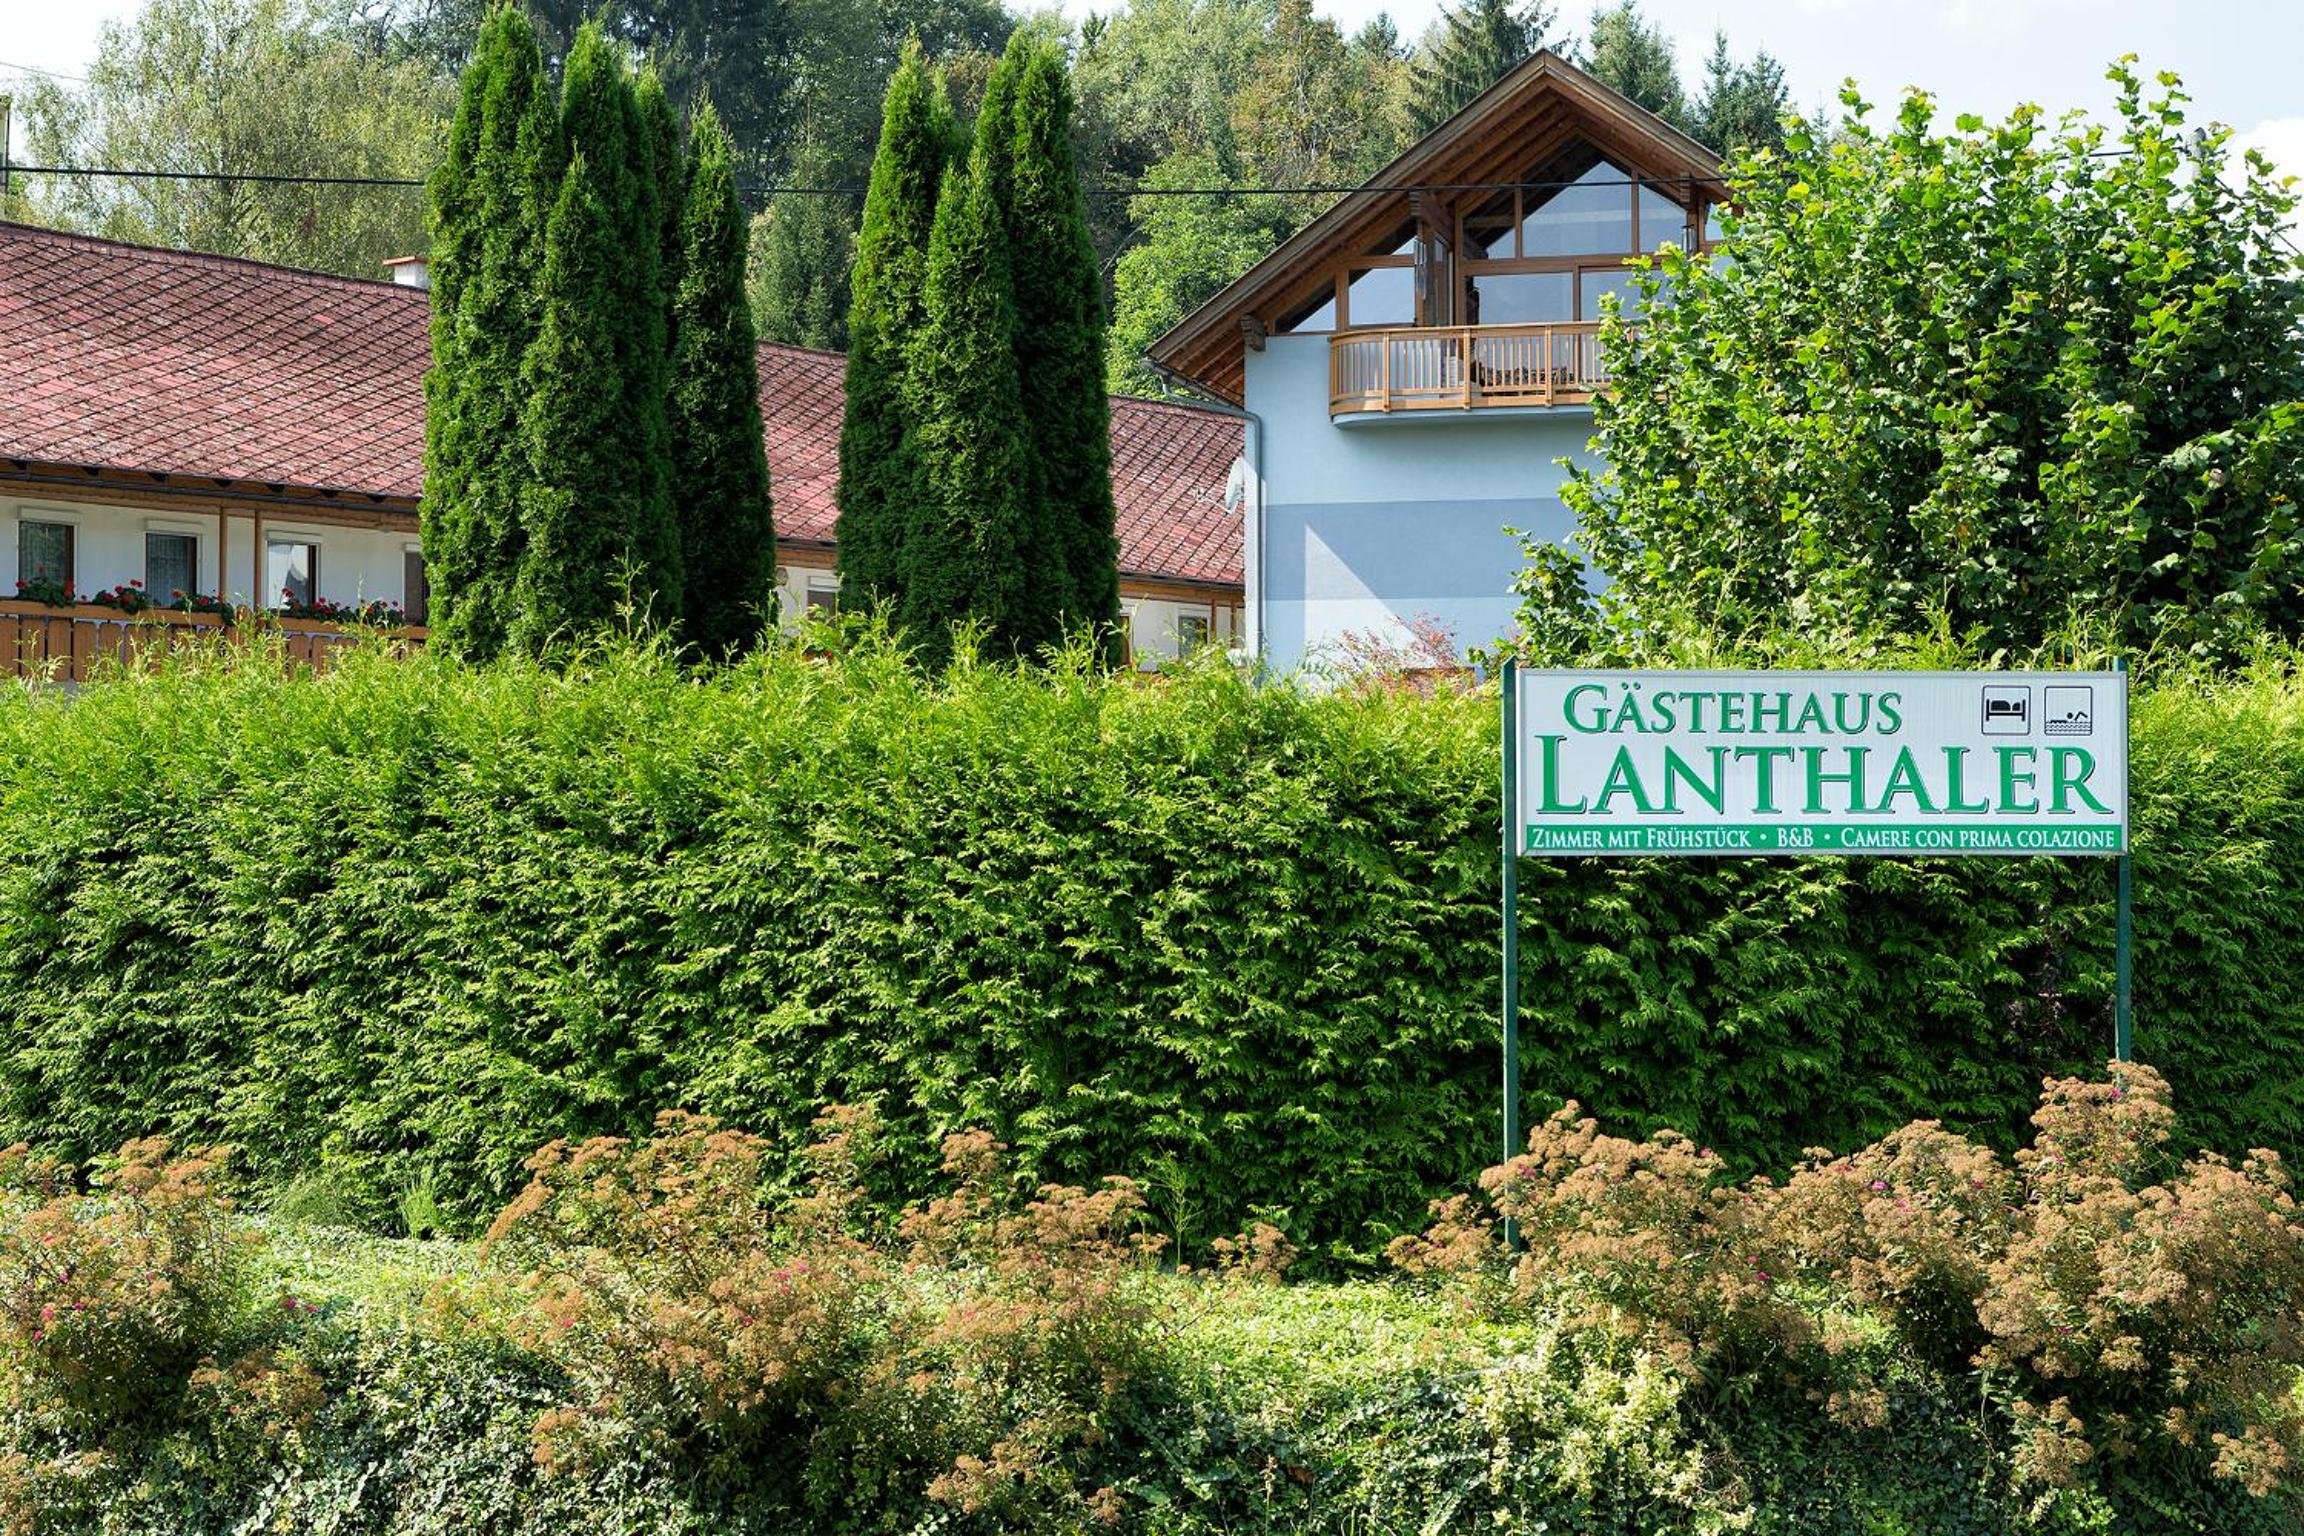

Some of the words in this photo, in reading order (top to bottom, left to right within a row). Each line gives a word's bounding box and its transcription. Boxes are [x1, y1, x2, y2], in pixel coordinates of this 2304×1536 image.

[1563, 682, 1902, 734] GÄSTEHAUS
[1535, 734, 2114, 814] LANTHALER
[1533, 829, 1604, 848] ZIMMER
[1608, 830, 1641, 847] MIT
[1647, 828, 1752, 848] FRÜHSTÜCK
[1777, 830, 1814, 847] B&B
[1841, 827, 1911, 848] CAMERE
[1914, 830, 1952, 848] CON
[1959, 830, 2014, 848] PRIMA
[2016, 830, 2115, 848] COLAZIONE
